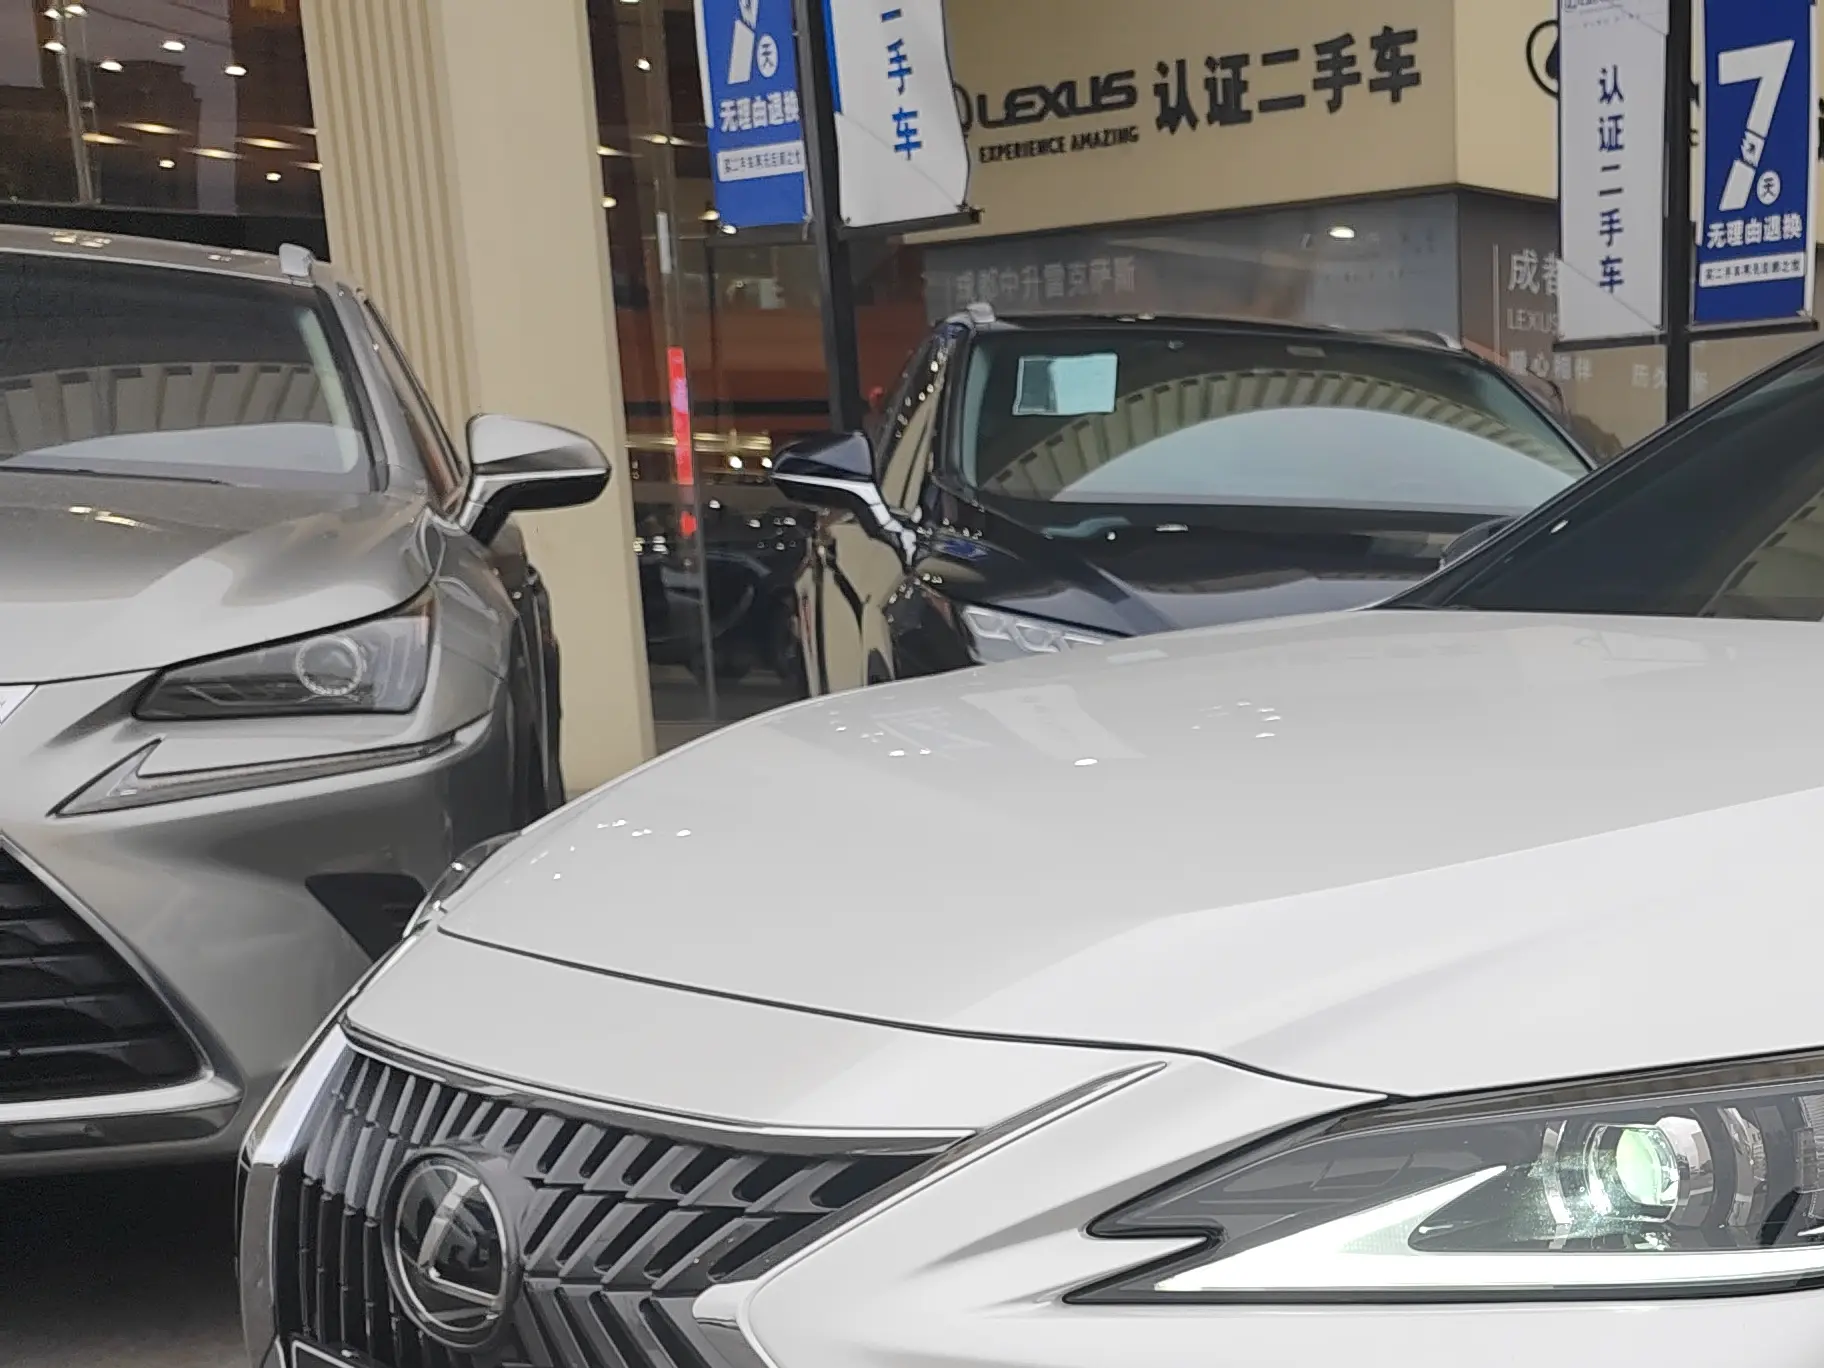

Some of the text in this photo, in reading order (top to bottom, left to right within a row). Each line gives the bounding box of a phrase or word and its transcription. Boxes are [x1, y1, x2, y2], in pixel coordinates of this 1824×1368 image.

[977, 69, 1137, 129] LEXUS
[1154, 25, 1421, 135] 认证二手车
[979, 125, 1140, 164] EXPERIENCE AMAZING
[1597, 64, 1625, 294] 认证二手车
[1706, 212, 1803, 249] 无理由退换
